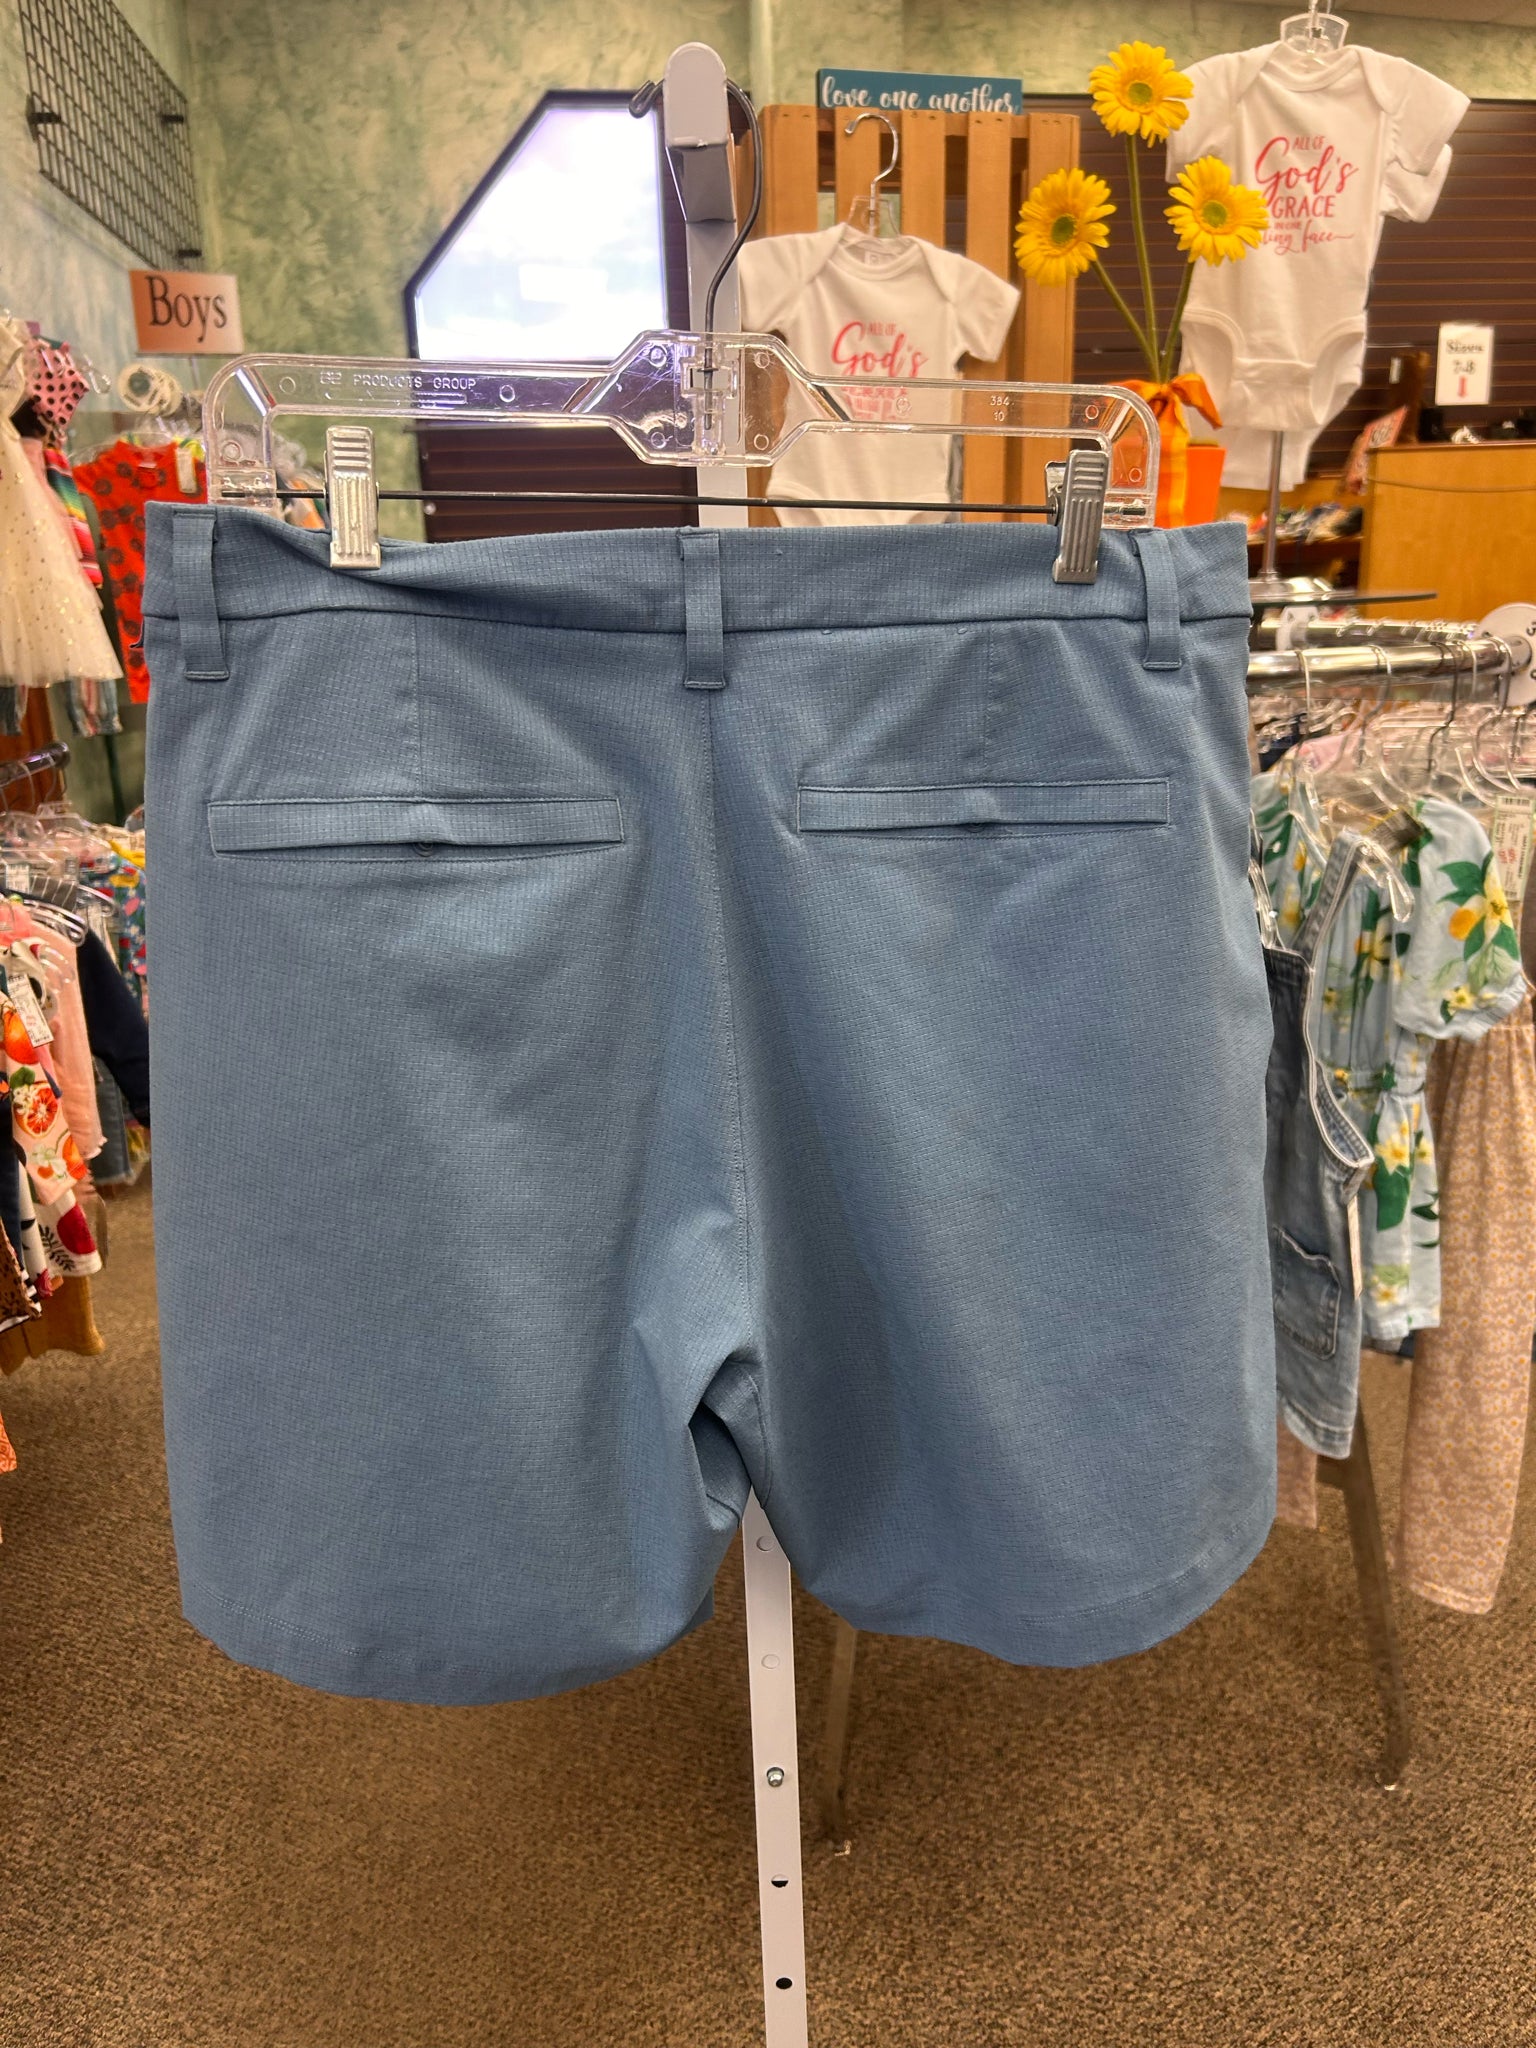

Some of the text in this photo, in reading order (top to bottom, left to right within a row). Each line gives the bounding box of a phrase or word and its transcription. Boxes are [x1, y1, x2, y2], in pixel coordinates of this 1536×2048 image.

[822, 76, 1018, 115] love one another
[1255, 136, 1359, 208] God's
[1271, 195, 1336, 219] GRACE
[145, 274, 227, 343] Boys
[831, 321, 928, 378] God's
[353, 374, 423, 388] PRODUCTS
[433, 377, 477, 390] GROUP
